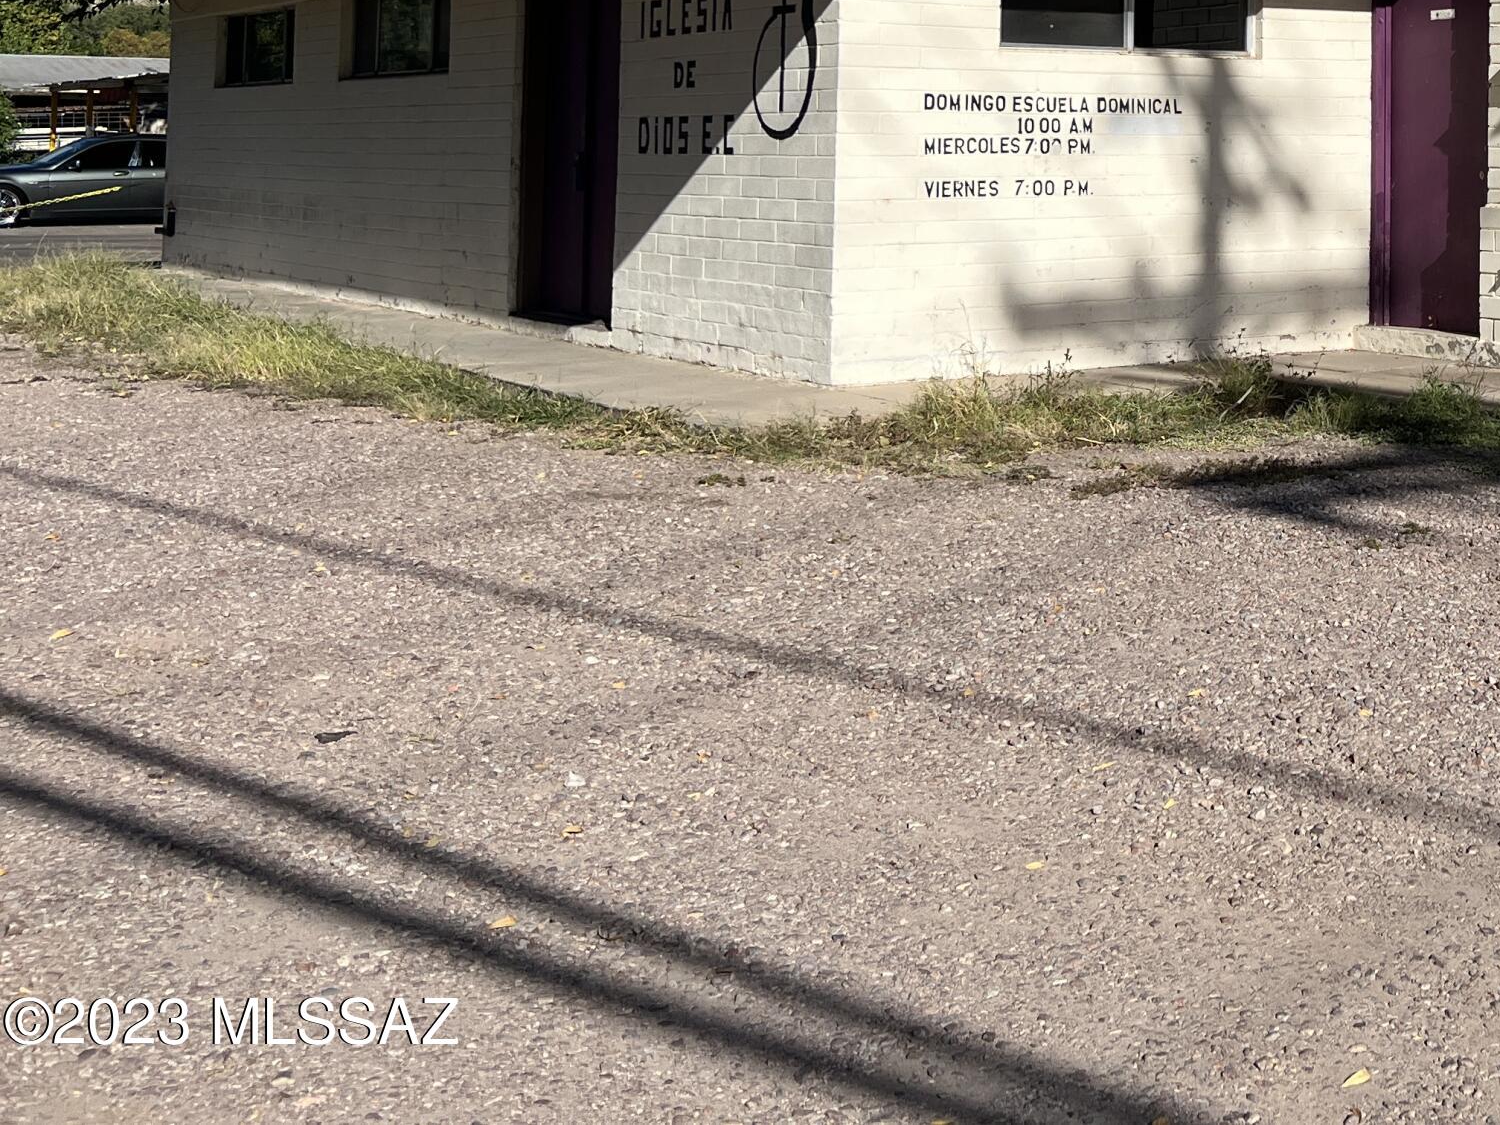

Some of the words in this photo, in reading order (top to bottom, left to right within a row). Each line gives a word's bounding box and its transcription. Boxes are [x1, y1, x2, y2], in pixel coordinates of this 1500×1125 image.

[673, 60, 696, 89] DE
[924, 93, 1006, 112] DOMINGO
[1012, 96, 1089, 113] ESCUELA
[1097, 97, 1182, 115] DOMINICAL
[924, 137, 1020, 155] MIERCOLES
[924, 180, 999, 198] VIERNES
[1015, 179, 1055, 196] 7:00
[1063, 180, 1094, 196] P.M.
